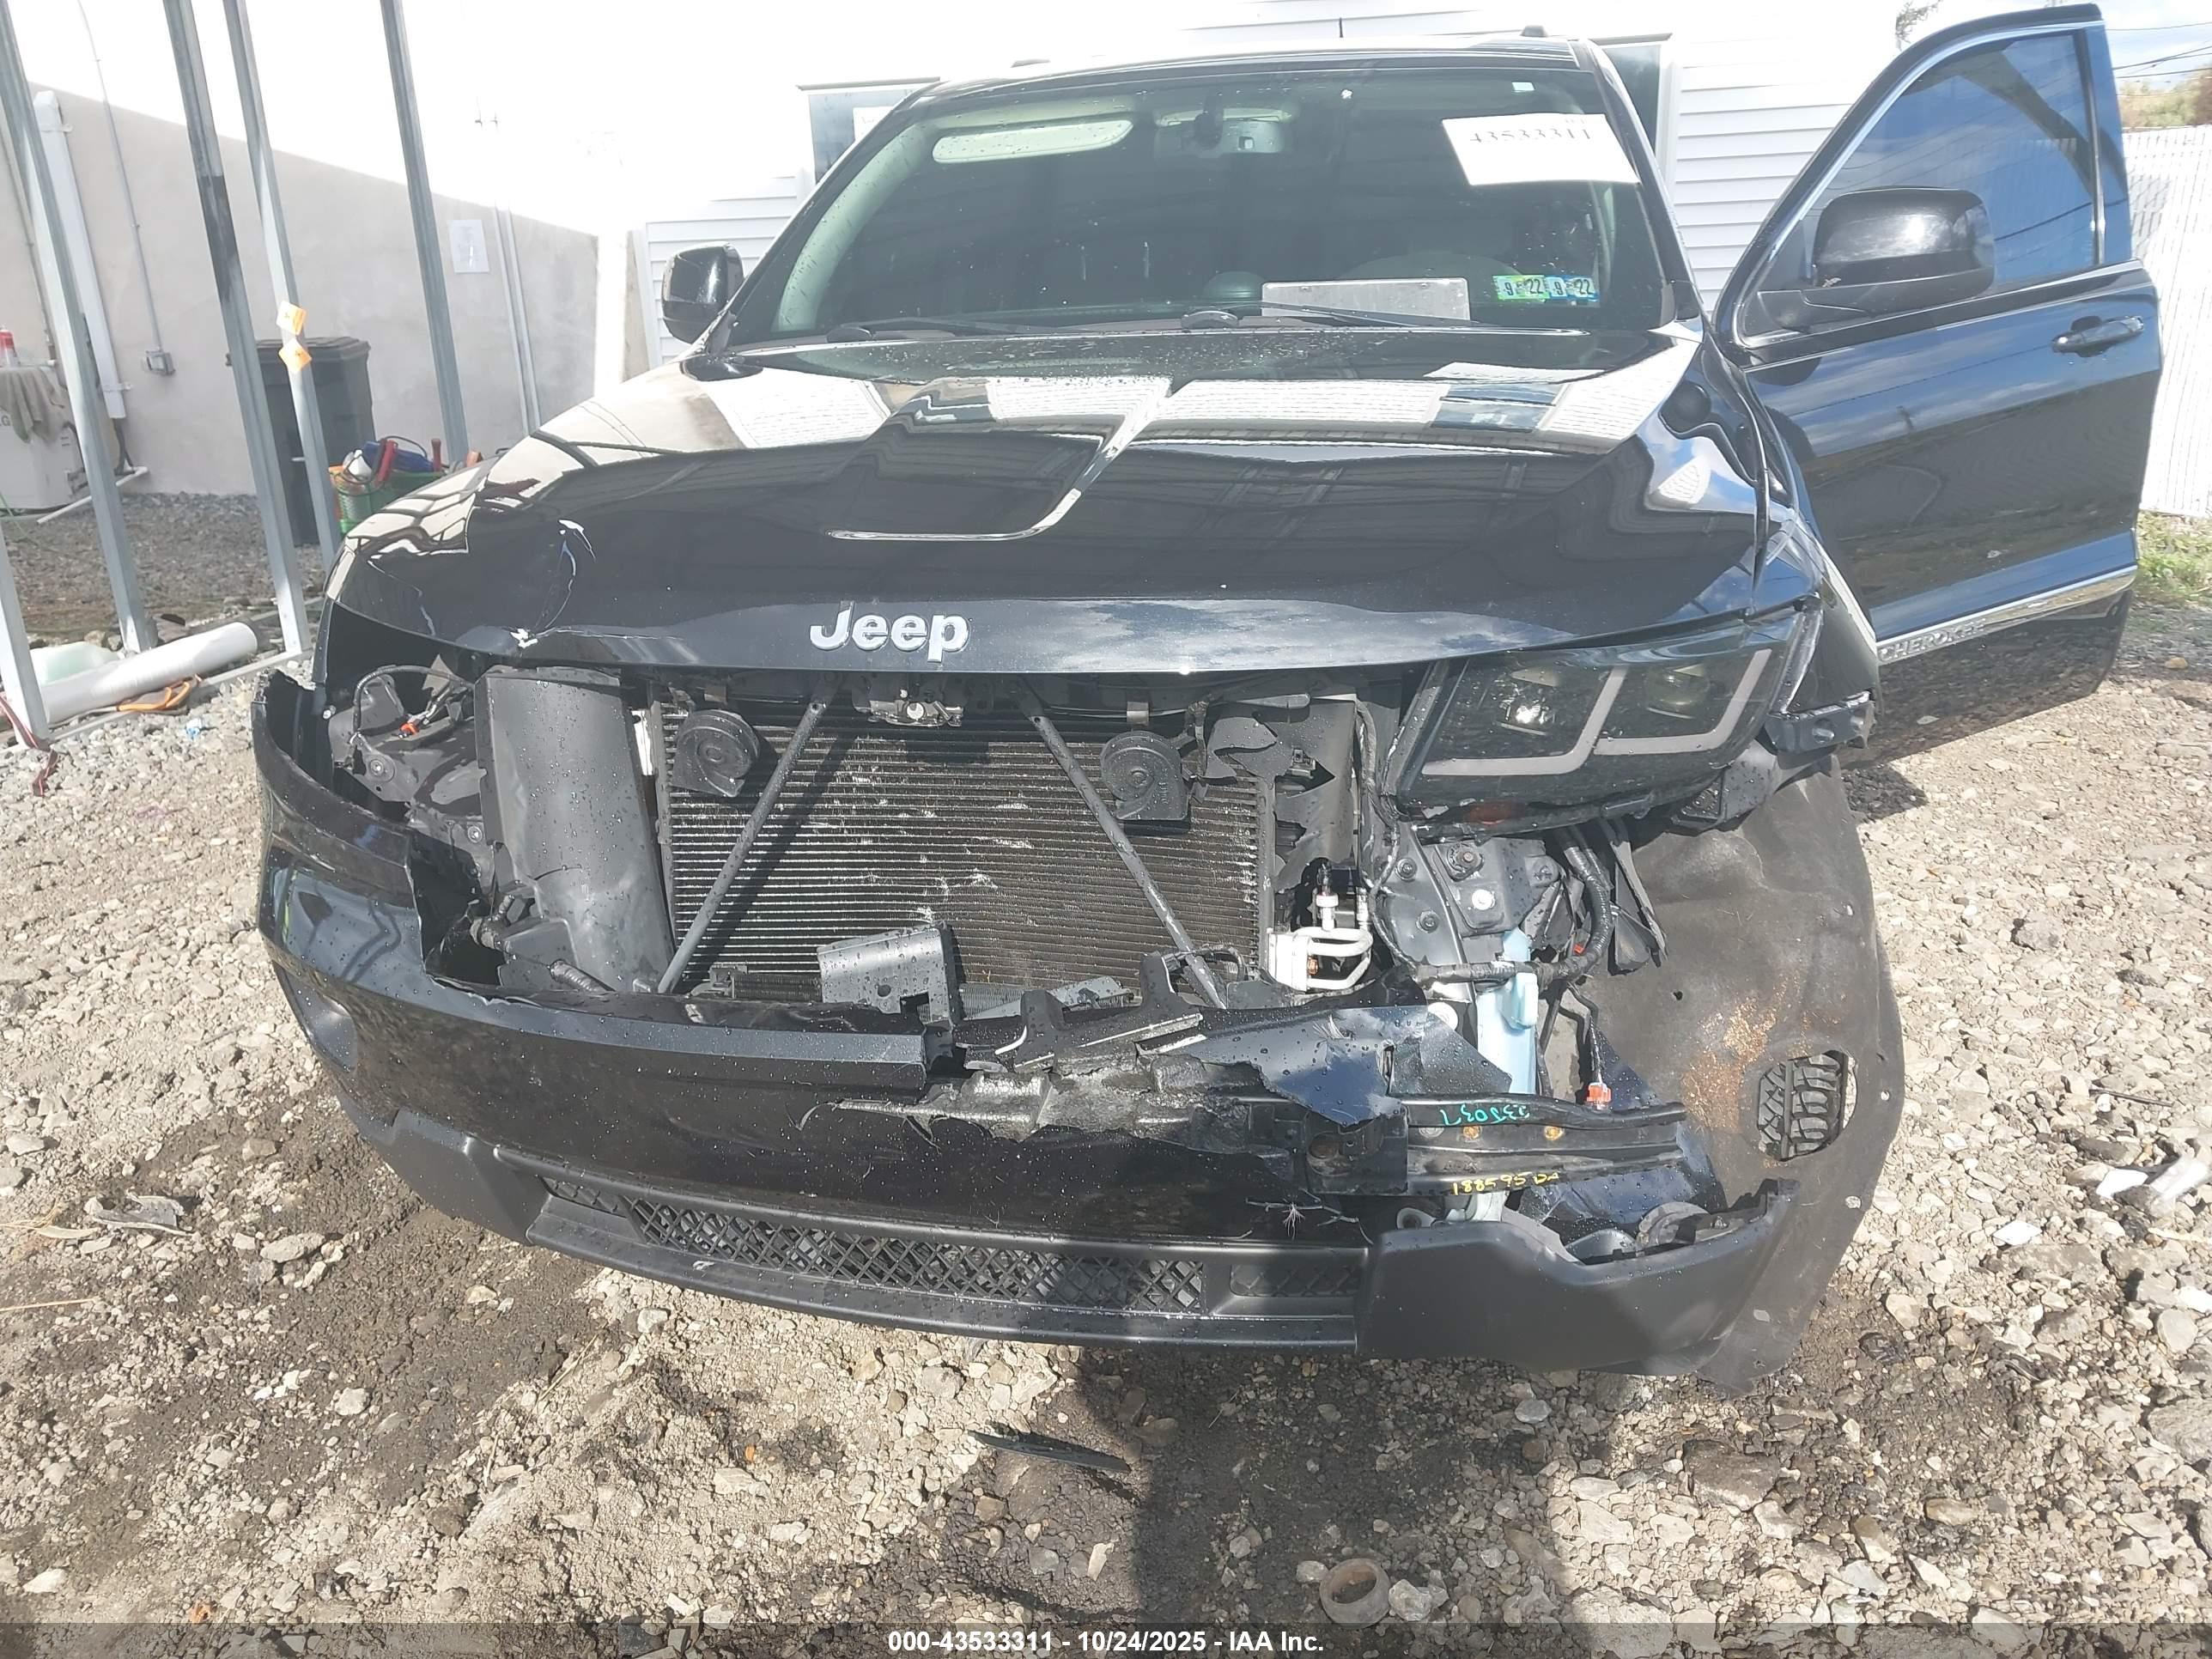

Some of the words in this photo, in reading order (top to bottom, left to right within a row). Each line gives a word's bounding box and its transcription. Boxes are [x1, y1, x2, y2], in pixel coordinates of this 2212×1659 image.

[1503, 281, 1514, 296] 9
[1525, 278, 1544, 295] 22
[1574, 278, 1595, 295] 22
[810, 600, 970, 663] Jeep
